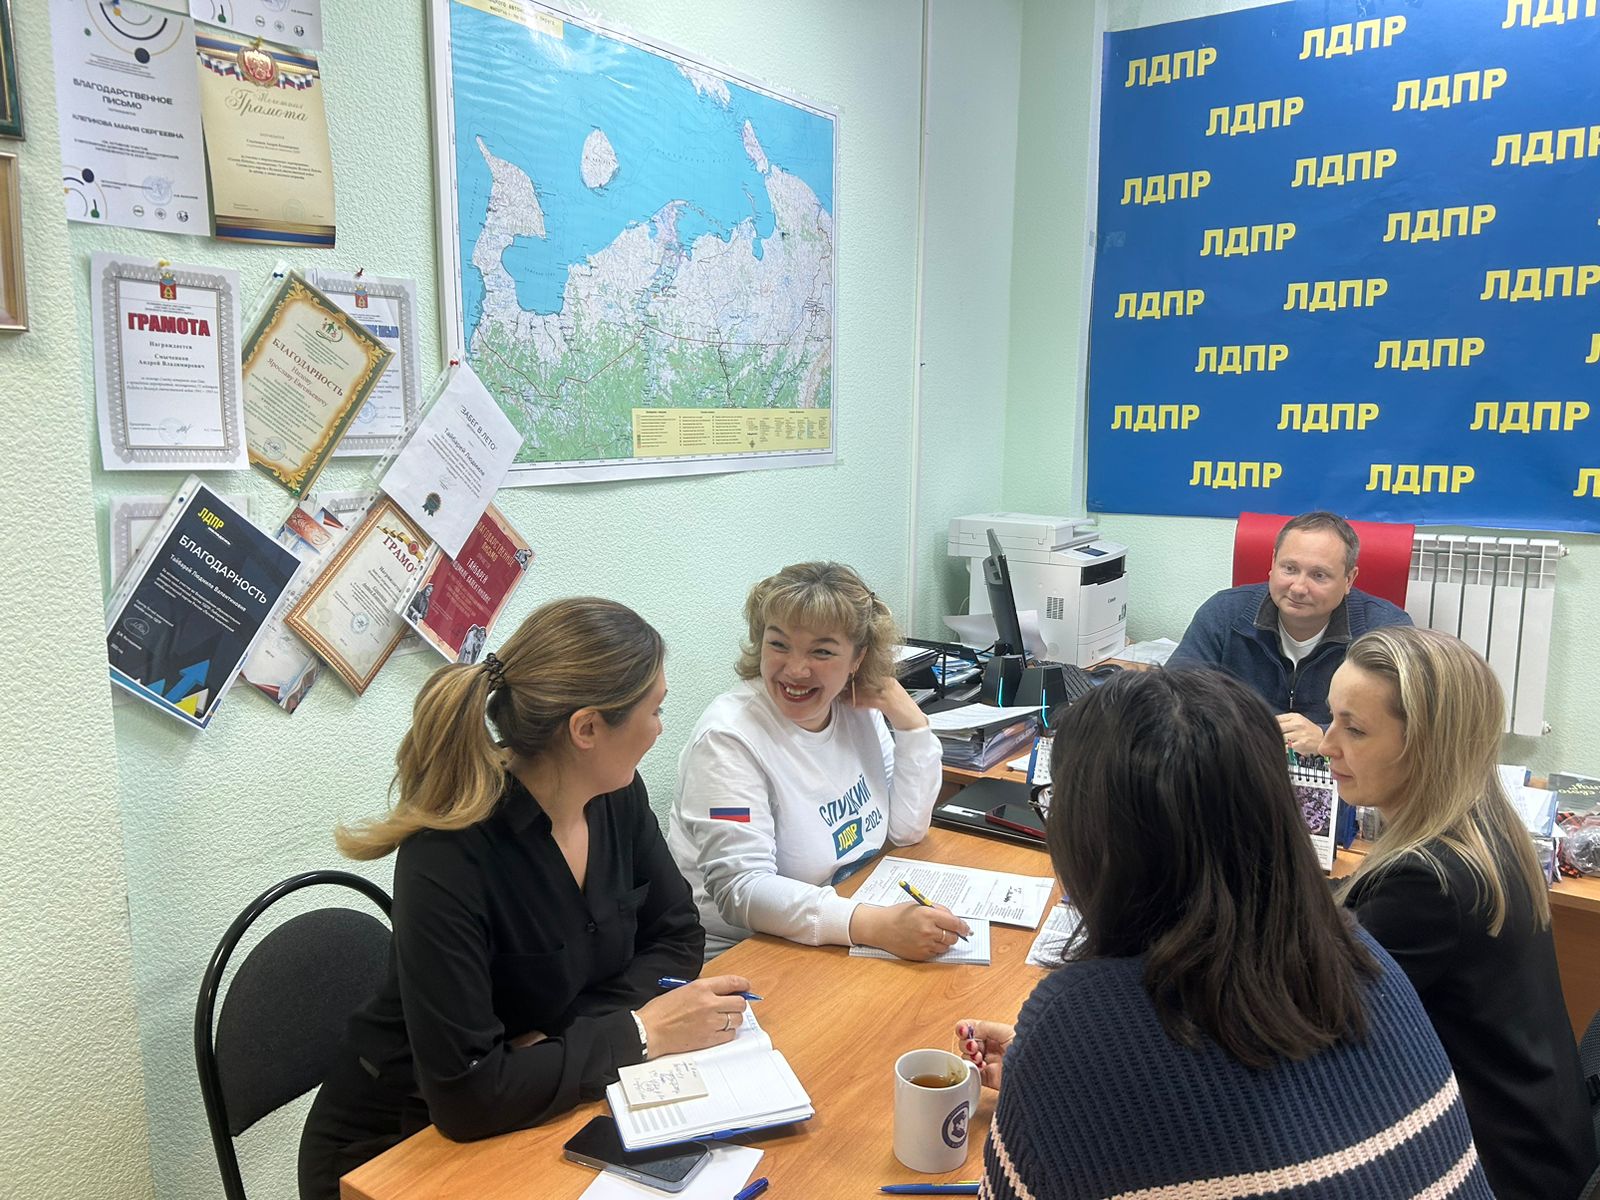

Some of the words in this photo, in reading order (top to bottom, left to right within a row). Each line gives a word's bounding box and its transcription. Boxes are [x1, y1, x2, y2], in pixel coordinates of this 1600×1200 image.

[1300, 16, 1406, 59] ЛДПР
[1126, 48, 1216, 87] ЛДПР
[73, 78, 173, 105] БЛАГОДАРСТВЕННОЕ
[102, 96, 142, 110] ПИСЬМО
[1392, 69, 1507, 111] ЛДПР
[1206, 97, 1304, 136] ЛДПР
[1292, 149, 1396, 187] ЛДПР
[1121, 171, 1210, 205] ЛДПР
[1201, 223, 1296, 257] ЛДПР
[1383, 205, 1496, 243] ЛДПР
[1284, 279, 1387, 312] ЛДПР
[1481, 265, 1600, 301] ЛДПР
[1115, 290, 1204, 319] ЛДПР
[128, 312, 211, 337] ГРАМОТА
[272, 338, 344, 397] БЛАГОДАРНОСТЬ
[1195, 345, 1288, 374] ЛДПР
[1375, 338, 1484, 370] ЛДПР
[1112, 405, 1199, 432] ЛДПР
[1277, 404, 1379, 432] ЛДПР
[1470, 402, 1589, 433] ЛДПР
[1190, 461, 1282, 489] ЛДПР
[1366, 464, 1474, 494] ЛДПР
[197, 507, 225, 530] ЛДПР
[178, 534, 268, 605] БЛАГОДАРНОСТЬ
[383, 536, 417, 574] ГРАМО
[169, 553, 193, 576] Тайбарей
[213, 585, 247, 612] Валентиновне
[819, 773, 872, 827] СЛУЦКИЙ
[865, 806, 884, 833] 2024
[838, 823, 858, 851] ЛДПР
